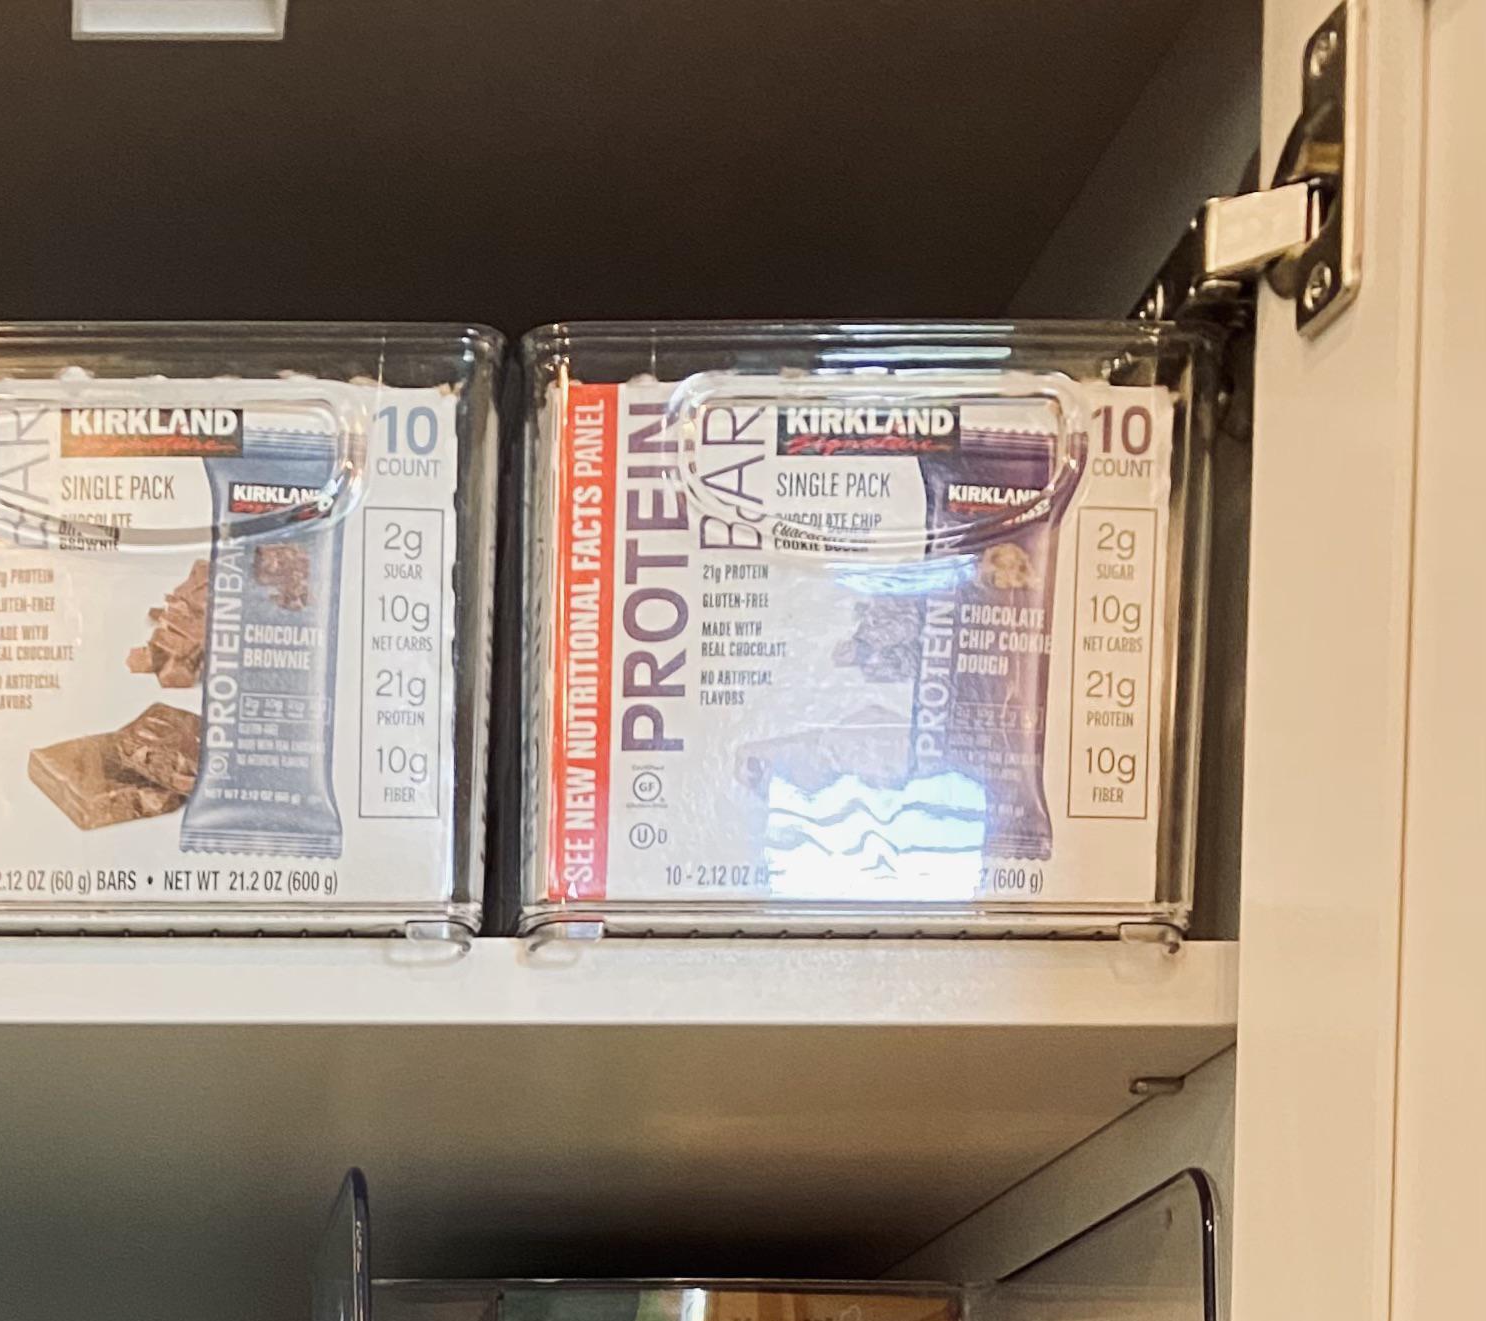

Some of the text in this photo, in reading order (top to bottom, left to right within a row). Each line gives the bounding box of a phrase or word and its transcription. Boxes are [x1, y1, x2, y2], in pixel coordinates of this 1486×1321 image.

[69, 408, 238, 436] KIRKLAND
[373, 406, 438, 455] 10
[786, 407, 954, 436] KIRKLAND
[1091, 406, 1152, 455] 10
[376, 459, 440, 477] COUNT
[1092, 459, 1153, 477] COUNT
[62, 476, 175, 500] SINGLE PACK
[776, 473, 891, 497] SINGLE PACK
[384, 523, 423, 560] 2g
[1097, 523, 1135, 560] 2g
[384, 564, 422, 578] SUGAR
[621, 402, 690, 751] PROTEIN
[725, 565, 768, 579] PROTEIN
[1096, 564, 1135, 579] SUGAR
[380, 595, 430, 631] 10g
[961, 604, 1045, 626] CHOCOLATE
[1090, 596, 1141, 633] 10g
[702, 621, 762, 637] MADE WITH
[959, 628, 1053, 651] CHIP COOKIE
[372, 636, 432, 651] NET CARBS
[565, 399, 604, 882] SEE NEW NUTRITIONAL FACTS PANEL
[1083, 636, 1142, 651] NET CARBS
[244, 649, 311, 669] BROWNIE
[957, 653, 1009, 675] DOUGH
[376, 669, 426, 706] 21g
[700, 691, 744, 705] FLAVORS
[1086, 671, 1135, 707] 21g
[377, 711, 424, 725] PROTEIN
[1087, 712, 1133, 727] PROTEIN
[377, 747, 427, 783] 10g
[1085, 747, 1136, 783] 10g
[384, 788, 415, 801] FIBER
[1092, 788, 1123, 802] FIBER
[27, 872, 45, 891] OZ
[97, 871, 136, 891] BARS
[164, 871, 320, 893] NET WT 21.2 OZ (600
[697, 866, 749, 886] 2.12 OZ
[993, 870, 1025, 892] (600
